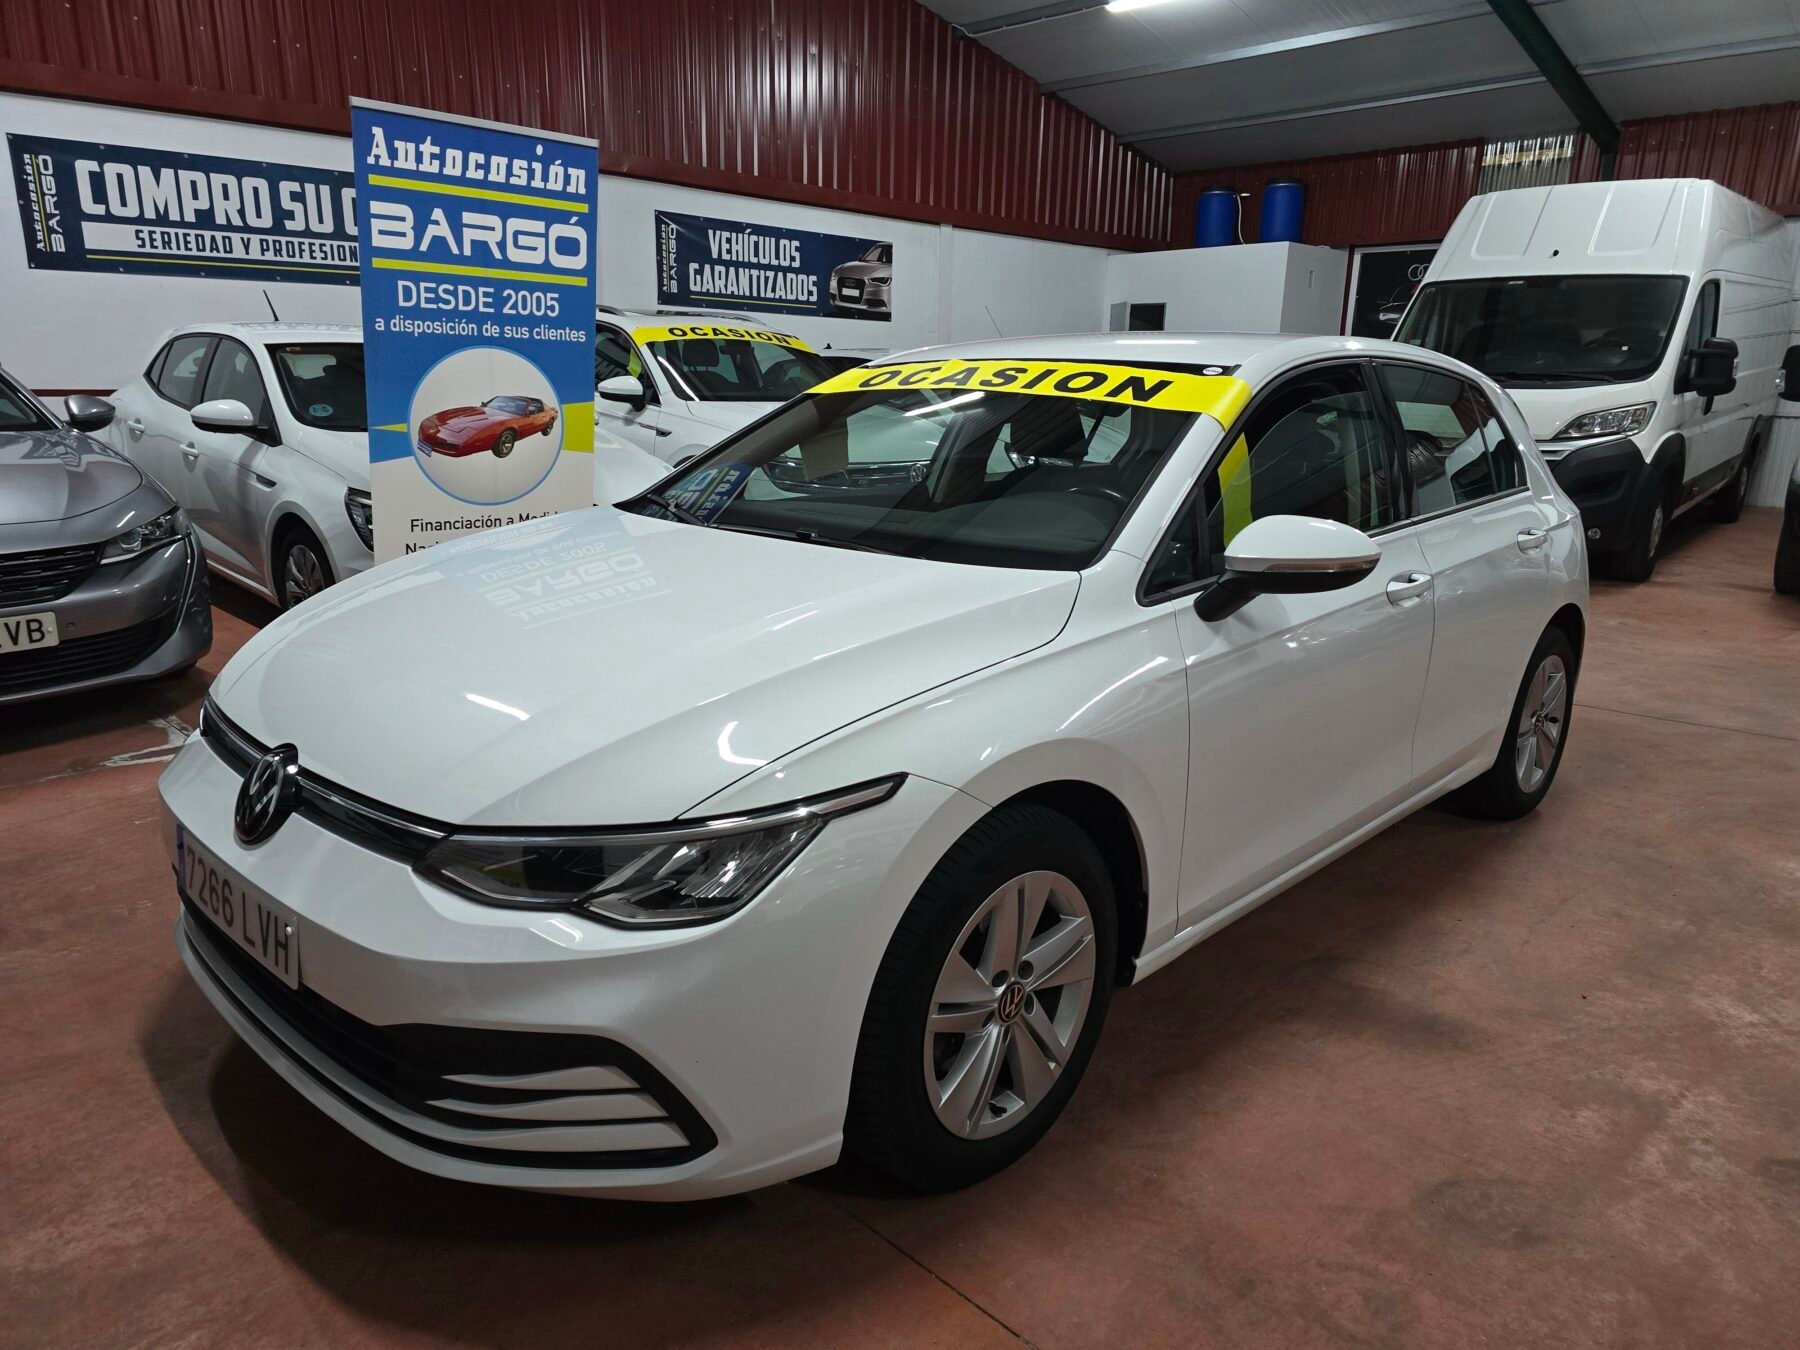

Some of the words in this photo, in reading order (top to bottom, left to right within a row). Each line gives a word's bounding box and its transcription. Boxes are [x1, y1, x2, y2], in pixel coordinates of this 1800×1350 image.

[367, 126, 586, 195] Autocasión
[74, 158, 274, 229] COMPRO
[278, 180, 335, 234] SU
[135, 228, 234, 255] SERIEDAD
[240, 236, 252, 257] Y
[369, 200, 588, 270] BARGÓ
[707, 228, 801, 268] VEHÍCULOS
[397, 279, 495, 313] DESDE
[502, 290, 560, 317] 2005
[688, 262, 818, 302] GARANTIZADOS
[375, 318, 385, 331] a
[390, 314, 478, 337] disposición
[482, 320, 500, 337] de
[504, 326, 529, 339] sus
[533, 325, 587, 342] clientes
[668, 327, 793, 346] OCASION
[858, 366, 1175, 403] OCASION
[410, 514, 502, 533] Financiación
[0, 619, 45, 648] VB
[187, 845, 234, 928] 7266
[242, 891, 289, 976] LVH
